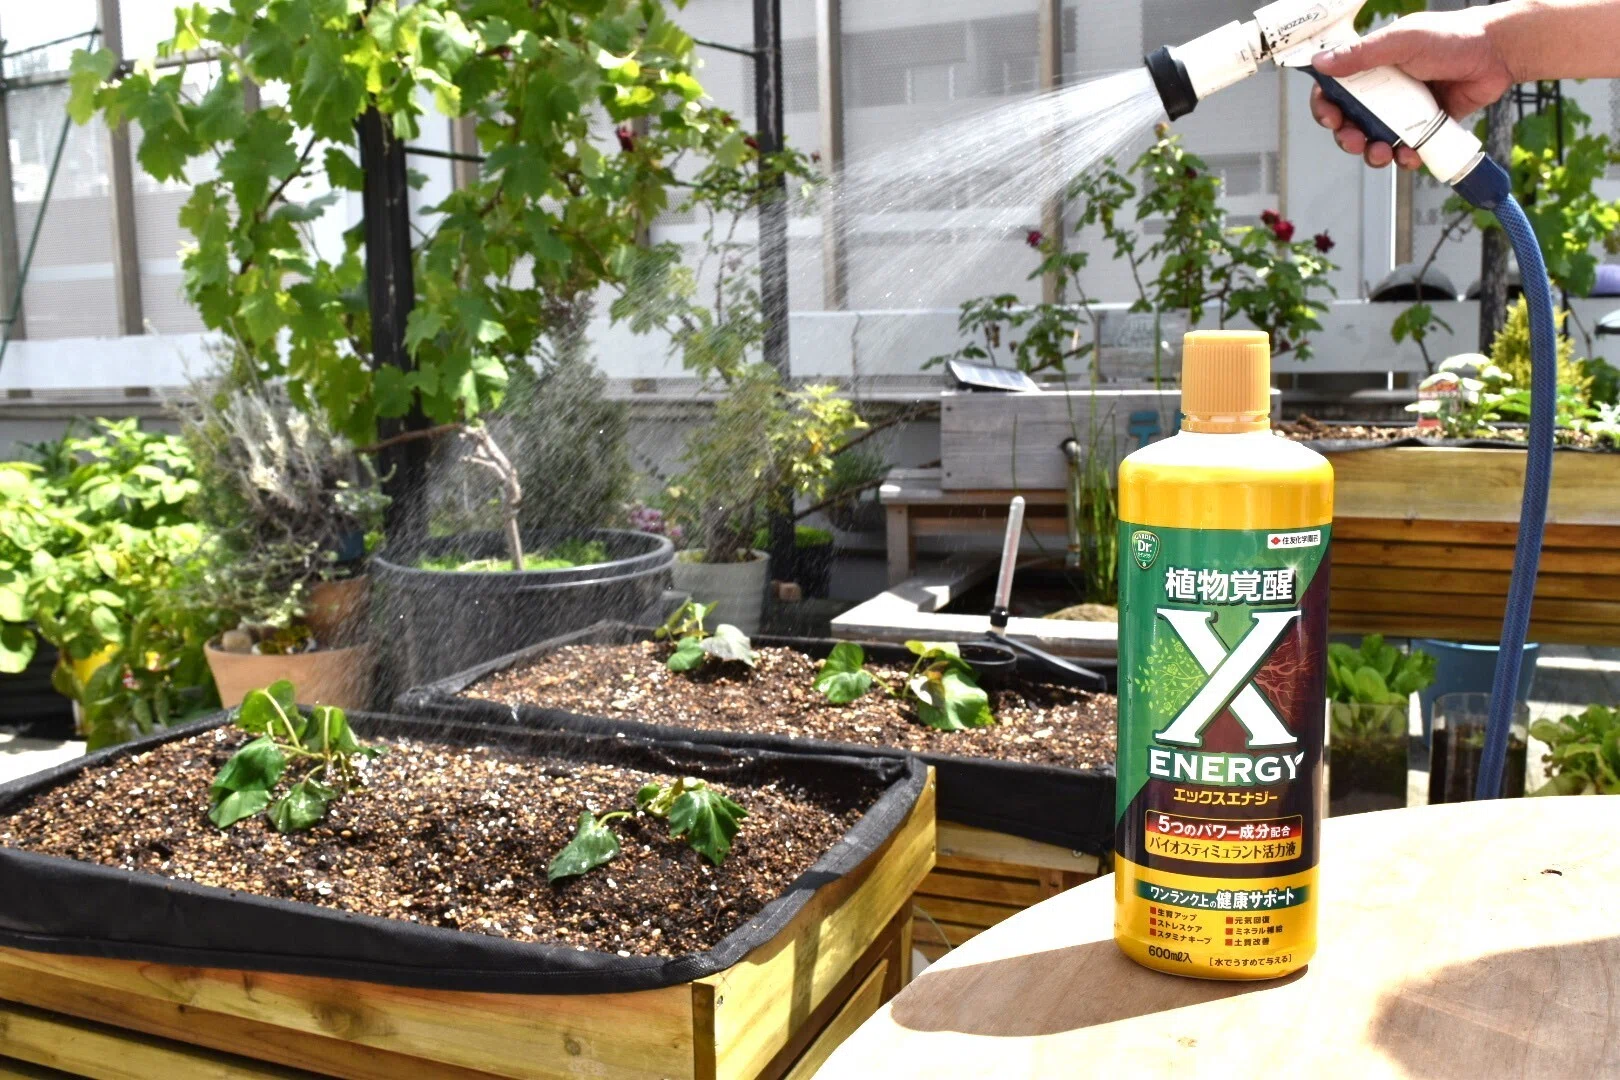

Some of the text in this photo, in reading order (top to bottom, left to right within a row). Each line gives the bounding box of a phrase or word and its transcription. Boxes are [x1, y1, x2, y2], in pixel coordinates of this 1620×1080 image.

[1137, 540, 1153, 552] Dr.
[1165, 566, 1296, 602] 植物覚醒
[1155, 608, 1302, 746] X
[1149, 748, 1304, 783] ENERGY
[1173, 787, 1278, 807] エックスエナジー
[1157, 815, 1291, 840] 5つのパワー成分配合
[1149, 837, 1296, 860] バイオスティミュラント活力液
[1149, 886, 1295, 910] ワンランク上の健康サポート
[1157, 908, 1198, 922] 生育アップ
[1234, 915, 1271, 925] 元気回復
[1157, 919, 1203, 933] ストレスケア
[1235, 925, 1283, 936] ミネラル補給
[1157, 930, 1212, 945] スタミナキープ
[1234, 937, 1270, 947] 土質改善
